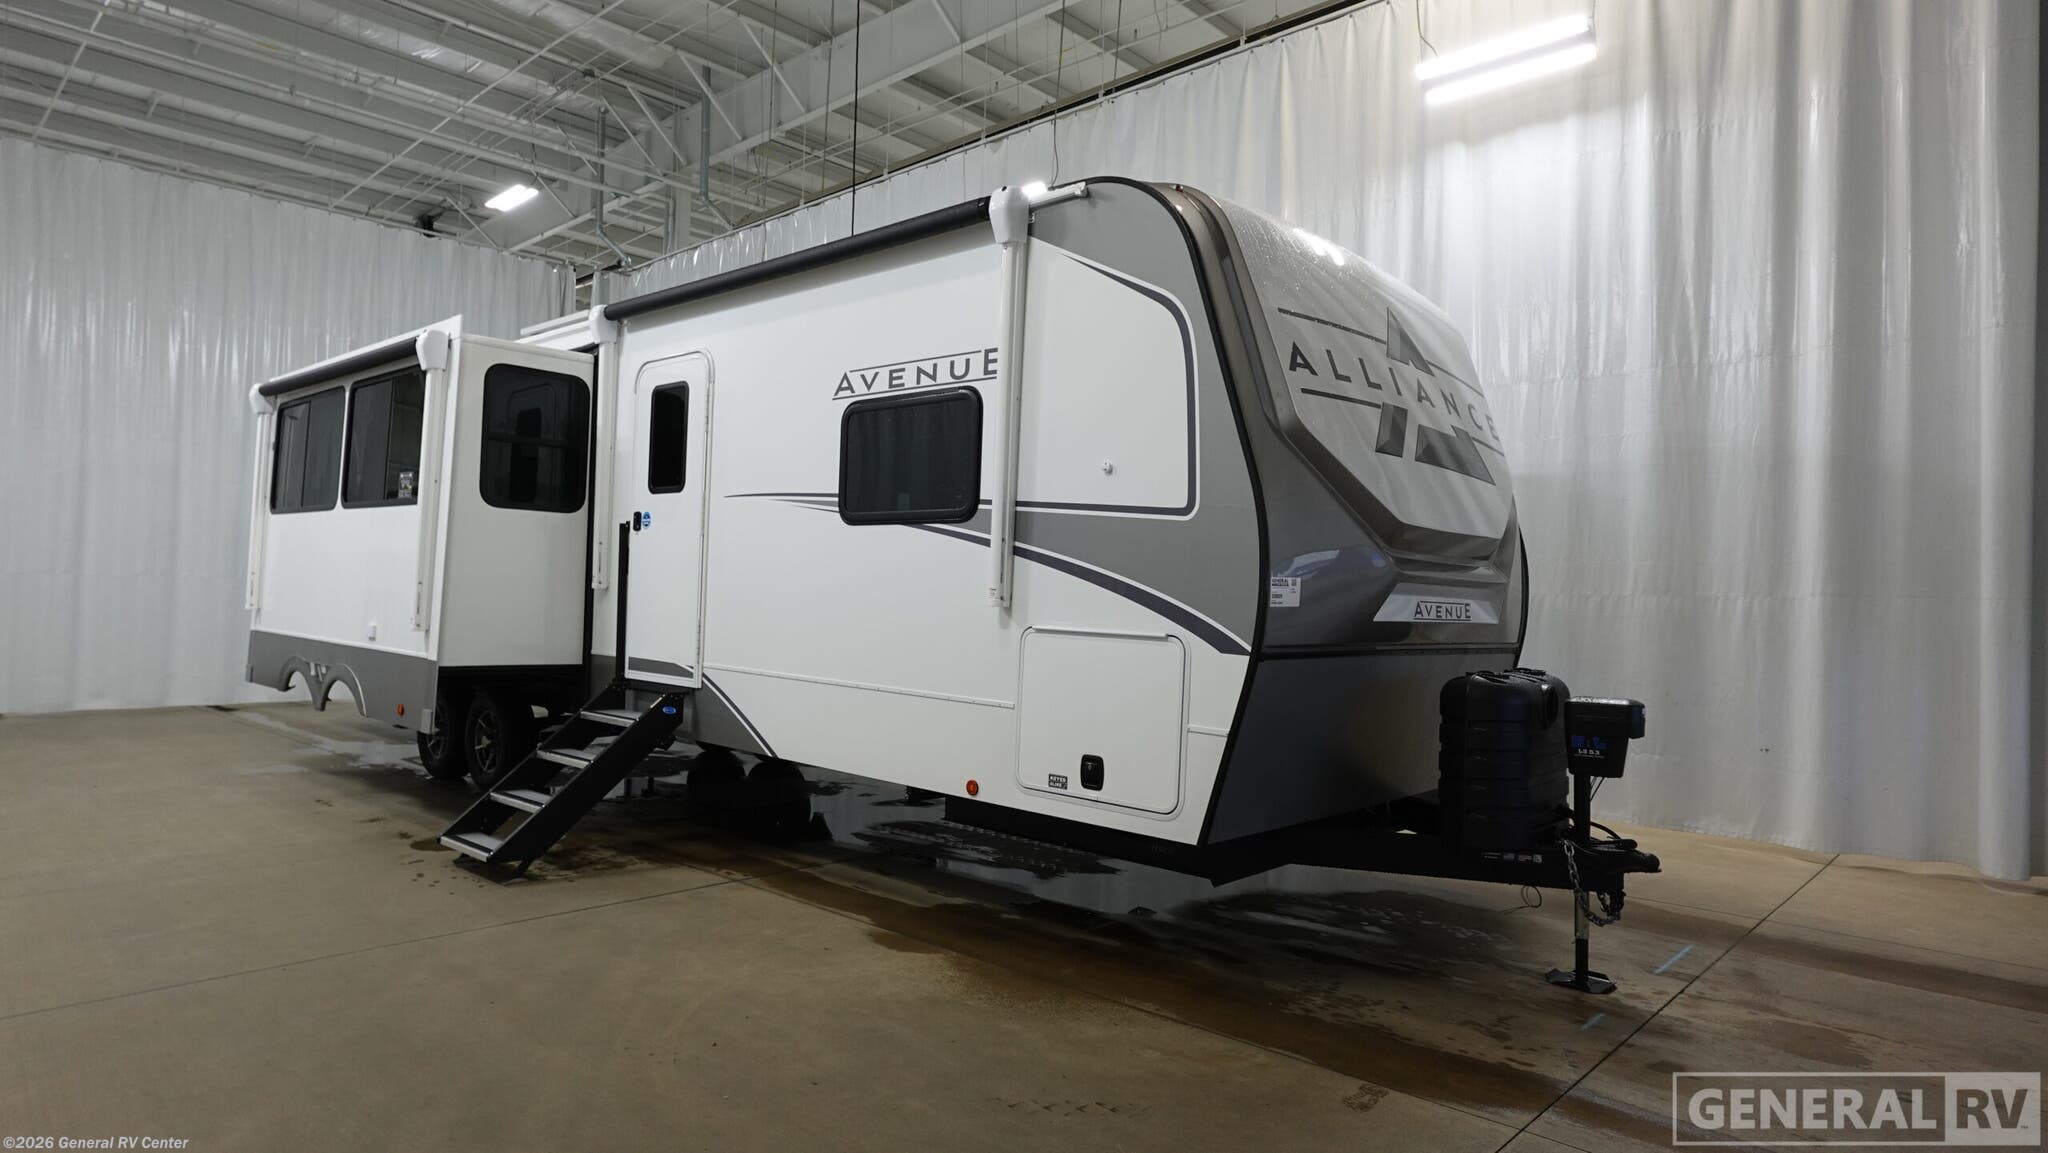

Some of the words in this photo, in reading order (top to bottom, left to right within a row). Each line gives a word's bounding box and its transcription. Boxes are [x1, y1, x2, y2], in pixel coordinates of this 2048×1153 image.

[833, 347, 999, 397] AVENUE
[1289, 341, 1500, 441] ALLIANCE
[1414, 601, 1471, 619] AVENUE
